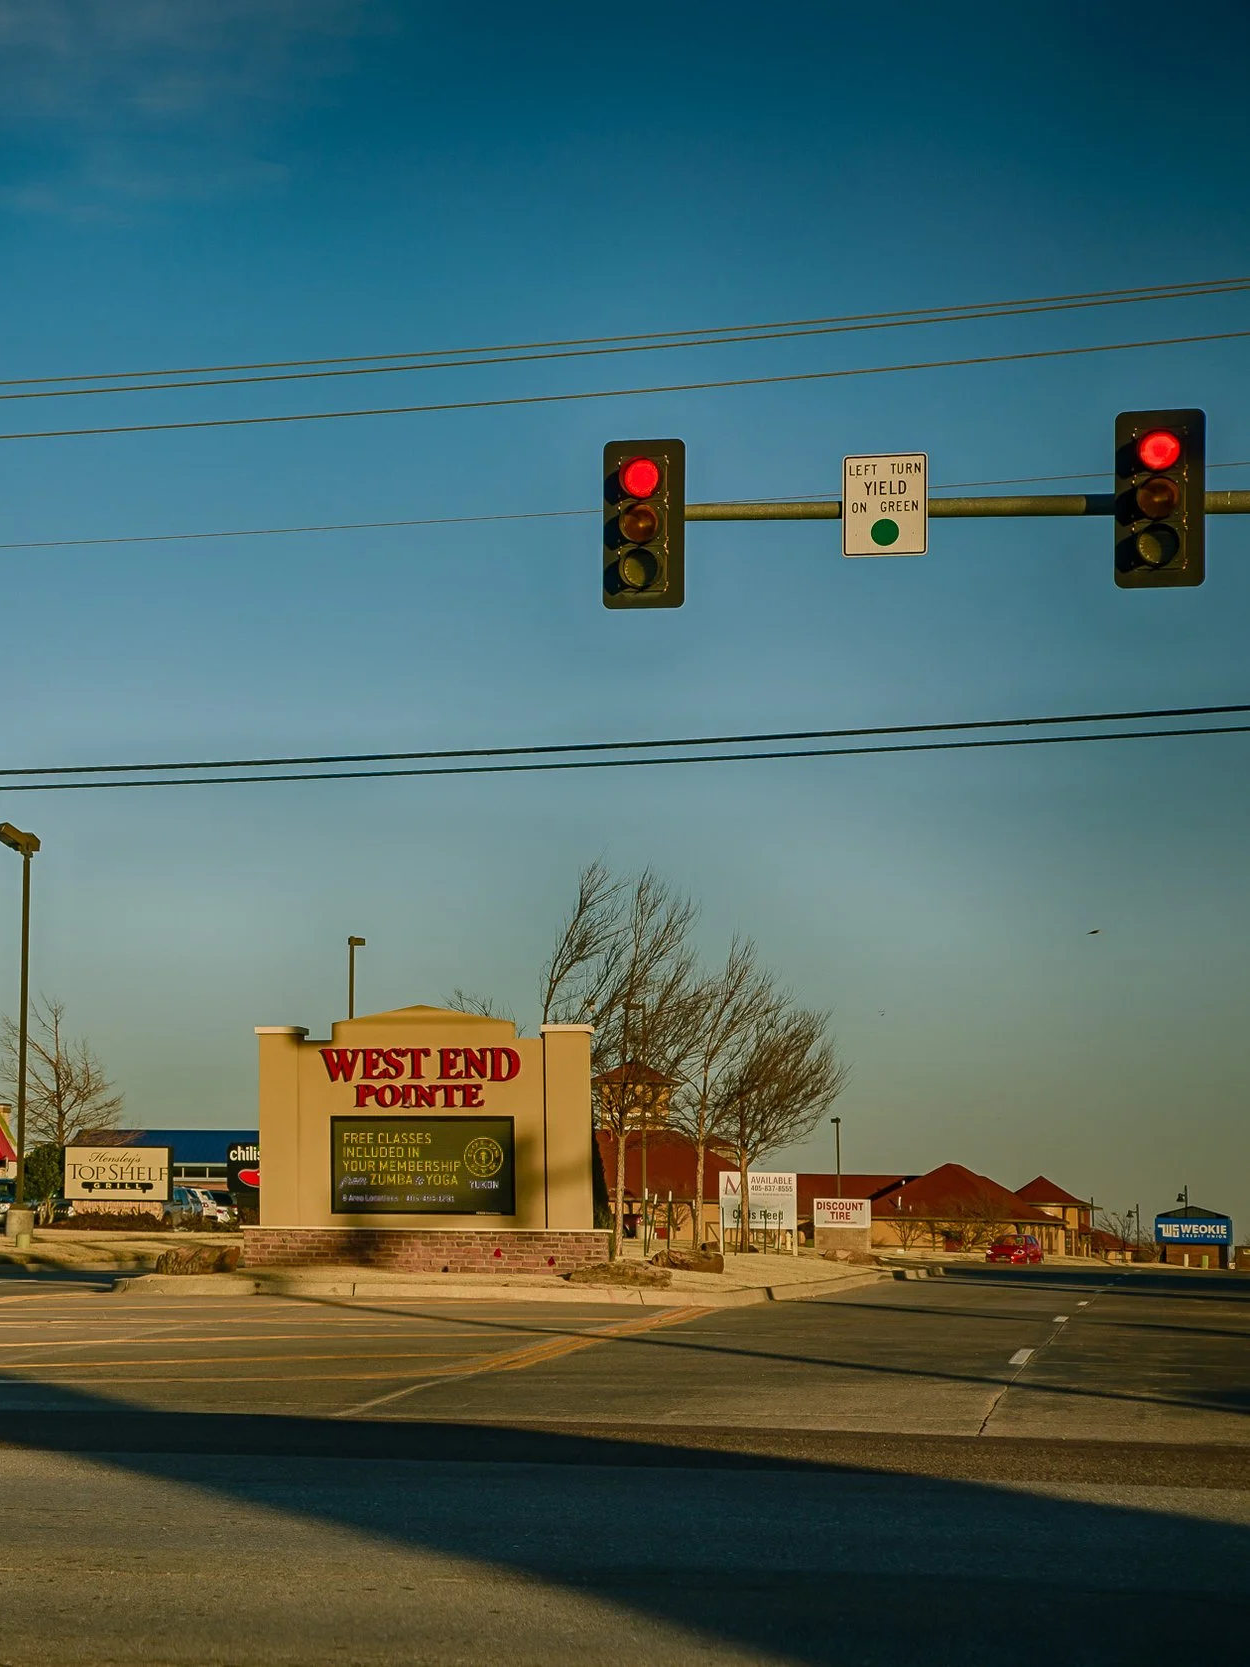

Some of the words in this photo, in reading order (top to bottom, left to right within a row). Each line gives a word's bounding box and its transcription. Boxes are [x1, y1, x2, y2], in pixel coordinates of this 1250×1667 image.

[849, 464, 877, 476] LEFT
[890, 462, 921, 474] TURN
[864, 480, 907, 495] YIELD
[851, 502, 867, 513] ON
[880, 500, 918, 512] GREEN
[319, 1048, 431, 1082] WEST
[437, 1047, 521, 1082] END
[354, 1083, 486, 1109] POINTE
[343, 1132, 374, 1144] FREE
[378, 1132, 432, 1144] CLASSES
[343, 1146, 404, 1158] INCLUDED
[408, 1146, 420, 1158] IN
[89, 1152, 141, 1171] Hensley's
[343, 1160, 375, 1172] YOUR
[379, 1160, 461, 1172] MEMBERSHIP
[370, 1173, 413, 1185] ZUMBA
[426, 1173, 458, 1185] YOGA
[470, 1181, 500, 1189] YUKON
[750, 1176, 793, 1184] AVAILABLE
[816, 1201, 864, 1211] DISCOUNT
[759, 1209, 784, 1220] Reed
[830, 1211, 851, 1220] TIRE
[1180, 1224, 1227, 1234] WEOKIE
